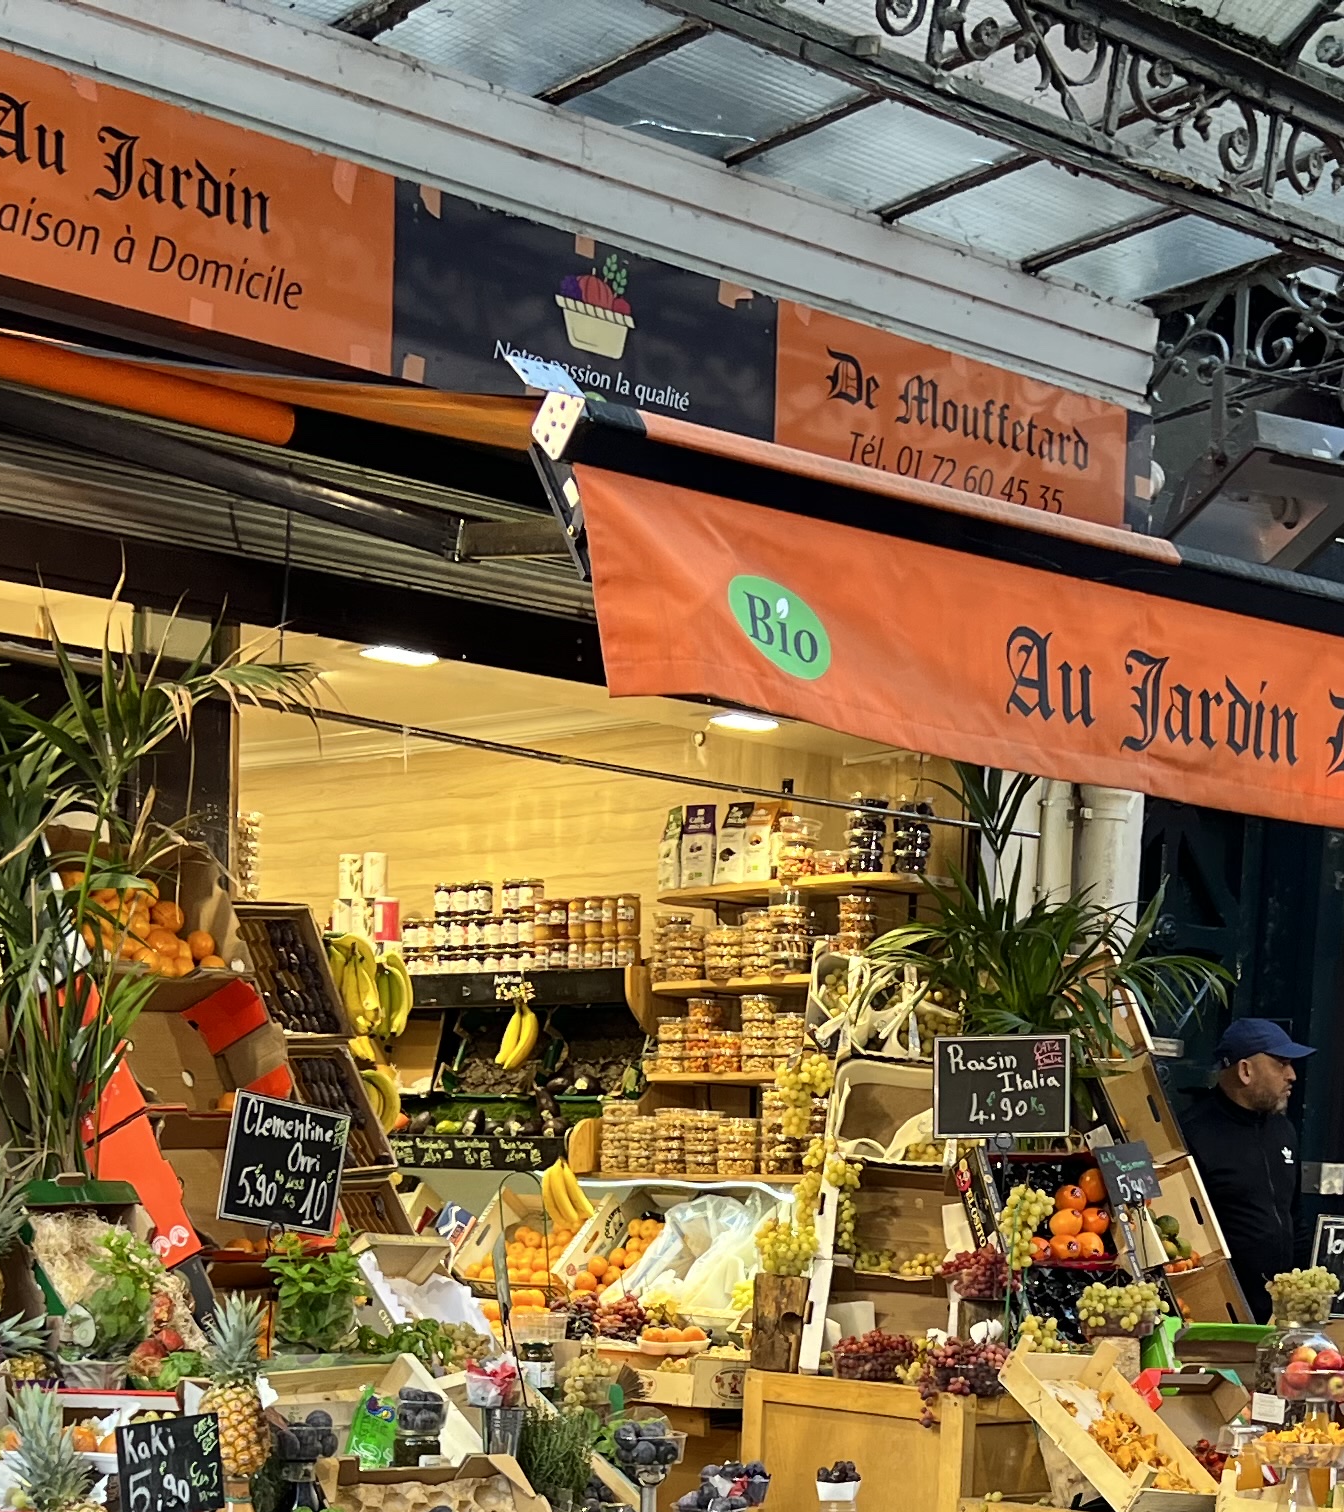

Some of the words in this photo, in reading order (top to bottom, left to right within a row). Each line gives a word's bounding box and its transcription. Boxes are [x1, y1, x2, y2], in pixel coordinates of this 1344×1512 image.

[92, 125, 272, 235] Jardin
[114, 223, 135, 264] à
[148, 235, 304, 312] Domicile
[615, 371, 630, 396] la
[634, 383, 691, 412] qualité
[825, 346, 880, 411] De
[895, 375, 1089, 473] Mouffetard
[849, 430, 887, 471] Tél.
[896, 445, 923, 478] 01
[929, 454, 957, 488] 72
[963, 465, 994, 496] 60
[1000, 476, 1030, 506] 45
[1039, 484, 1065, 514] 35
[742, 590, 821, 666] Bio
[1004, 625, 1095, 729] Au
[1119, 649, 1299, 766] Jardin
[947, 1044, 1017, 1074] Raisin
[997, 1069, 1061, 1092] Italia
[243, 1097, 334, 1143] Clementine
[287, 1142, 321, 1174] Orri
